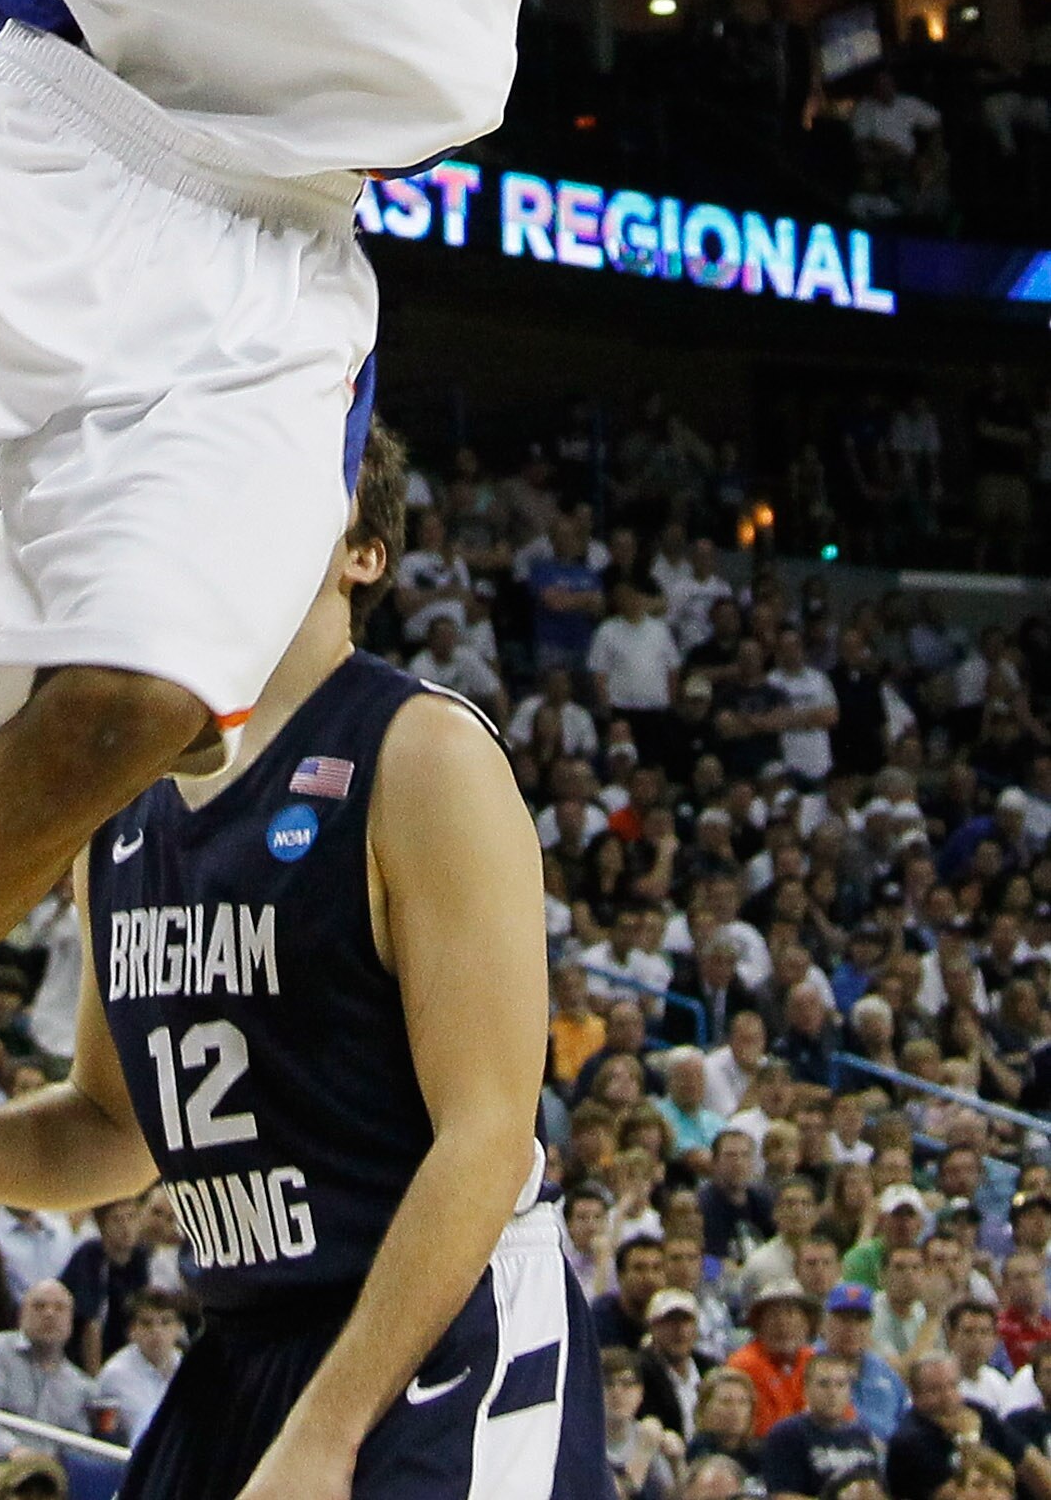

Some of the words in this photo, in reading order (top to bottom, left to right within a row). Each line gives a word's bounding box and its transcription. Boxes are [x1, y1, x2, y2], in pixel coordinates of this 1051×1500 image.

[501, 169, 896, 315] REGIONAL
[109, 902, 280, 1002] BRIGHAM
[147, 1018, 259, 1152] 12
